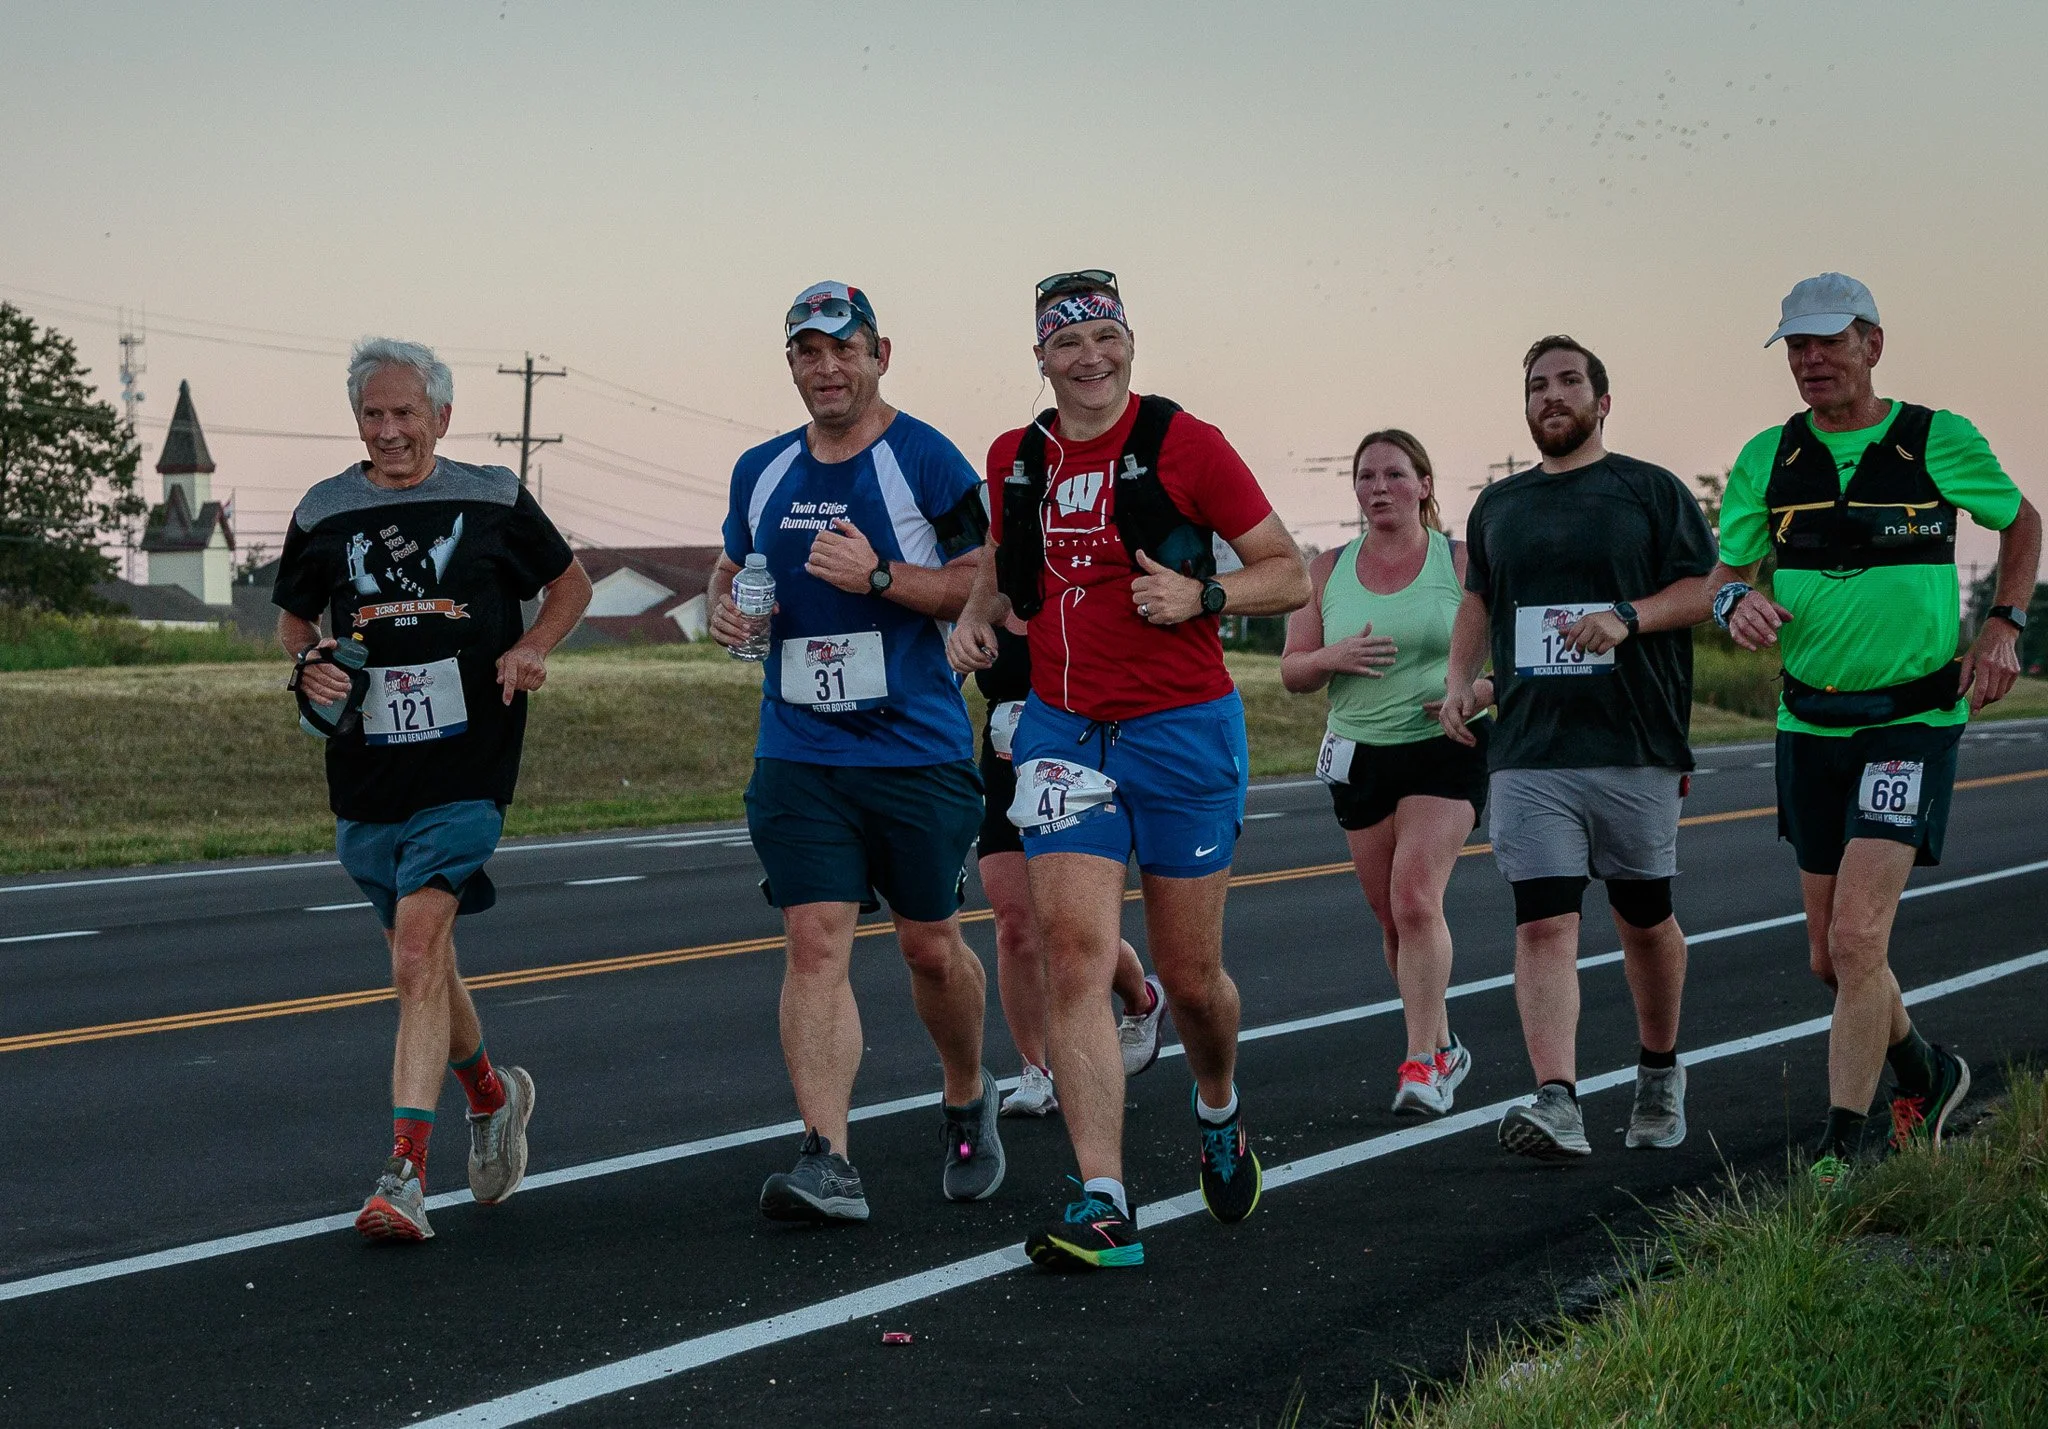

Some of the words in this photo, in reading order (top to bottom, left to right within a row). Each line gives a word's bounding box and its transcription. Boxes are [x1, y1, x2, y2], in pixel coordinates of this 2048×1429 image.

[1055, 472, 1104, 518] W
[790, 501, 817, 514] Twin
[818, 501, 848, 515] Cities
[780, 516, 828, 532] Running
[1885, 522, 1942, 535] naked
[380, 525, 399, 539] Run
[385, 536, 405, 550] You
[374, 604, 400, 616] JCRRC
[401, 603, 415, 612] PIE
[417, 602, 435, 611] RUN
[394, 616, 419, 627] 2018
[1533, 666, 1561, 676] NICKOLAS
[1562, 665, 1593, 675] WILLIAMS
[814, 667, 846, 702] 31
[388, 696, 435, 731] 121
[812, 703, 831, 713] PETER
[831, 701, 857, 712] BOYSEN
[387, 733, 408, 744] ALLAN
[1320, 745, 1333, 773] 49
[1871, 779, 1908, 812] 68
[1037, 786, 1069, 820] 47
[1864, 812, 1883, 822] KEITH
[1040, 825, 1052, 835] JAY
[1052, 815, 1080, 832] ERDAHL
